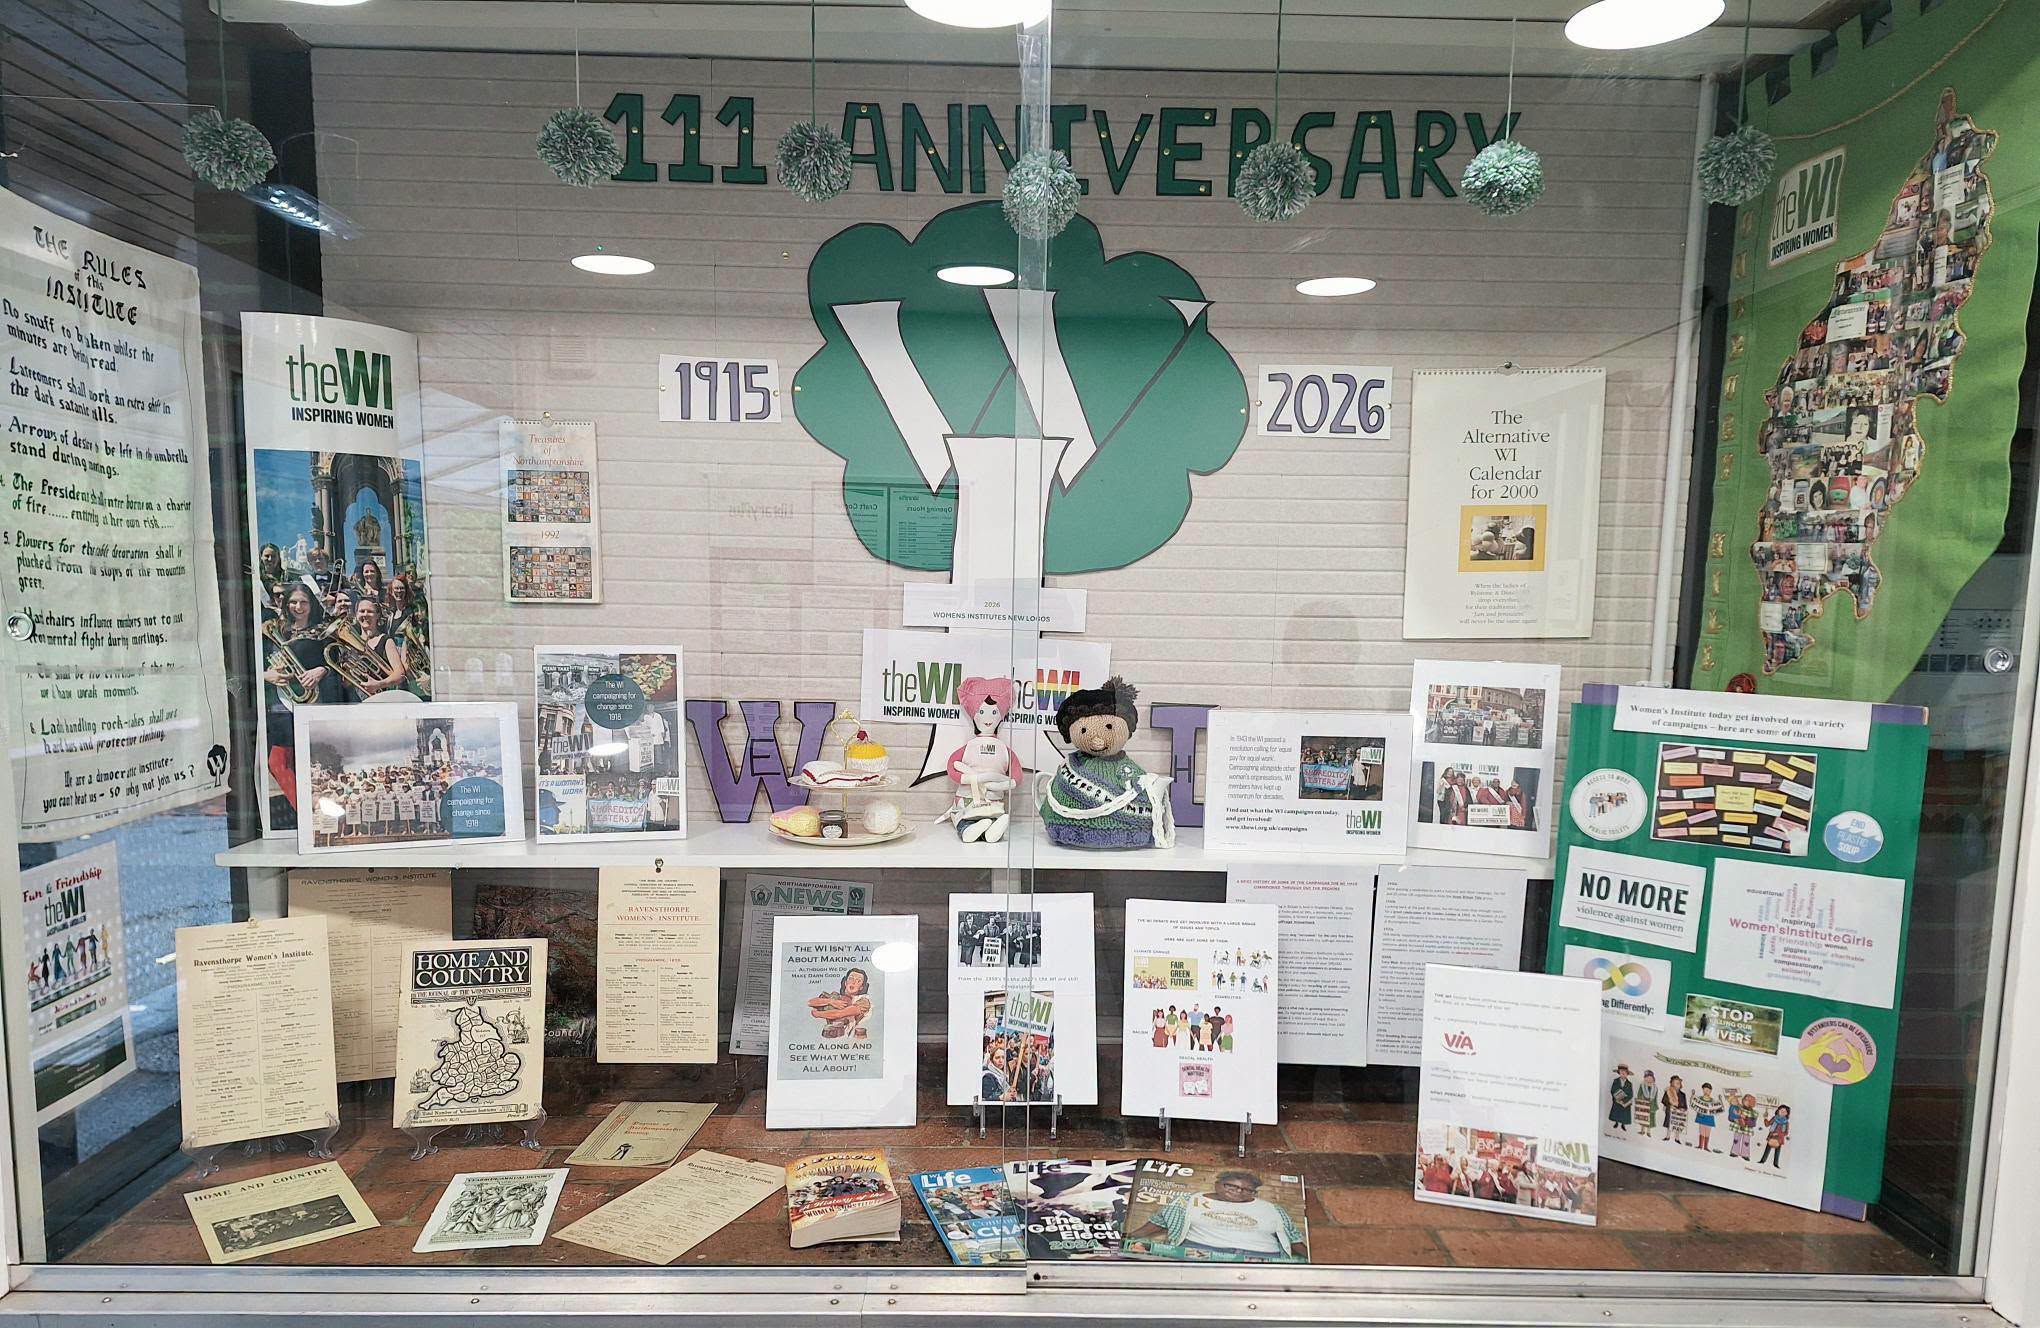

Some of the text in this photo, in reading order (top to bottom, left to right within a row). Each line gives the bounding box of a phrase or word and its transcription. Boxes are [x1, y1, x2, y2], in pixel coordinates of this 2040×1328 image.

[604, 93, 768, 185] 111
[1803, 223, 1833, 247] WOMEN
[82, 251, 147, 289] RULES
[25, 313, 54, 333] snuff
[675, 361, 771, 421] 1915
[1267, 372, 1385, 434] 2026
[292, 407, 394, 429] INSPIRING WOMEN
[1491, 410, 1522, 425] The
[1462, 430, 1550, 444] Alternative
[10, 442, 46, 459] stand
[1495, 448, 1517, 462] WI
[1469, 467, 1542, 480] Calendar
[1472, 485, 1538, 499] for 2000
[883, 706, 960, 719] INSPIRING WOMEN
[1630, 705, 1668, 715] Women's
[1670, 708, 1706, 718] Institute
[1709, 711, 1732, 721] today
[1735, 712, 1749, 722] get
[1751, 713, 1789, 725] involved
[1652, 718, 1660, 726] of
[1662, 720, 1707, 731] campaigns
[1718, 724, 1736, 732] here
[1739, 726, 1754, 734] are
[1782, 727, 1791, 737] of
[1793, 729, 1816, 739] them
[23, 867, 101, 902] Fun Friendship
[774, 887, 844, 907] NEWS
[1580, 872, 1689, 916] NO MORE
[1577, 905, 1684, 933] violence against women
[1782, 918, 1815, 928] inspiring
[193, 957, 242, 967] Ravensthorpe
[246, 953, 278, 962] Women's
[417, 950, 528, 970] HOME AND
[1170, 961, 1184, 969] FAIR
[416, 965, 527, 986] COUNTRY
[1170, 970, 1190, 978] GREEN
[1170, 978, 1194, 986] FUTURE
[1711, 1006, 1753, 1023] STOP
[1014, 1161, 1062, 1175] Life
[1142, 1160, 1194, 1177] Life
[921, 1171, 971, 1188] Life
[194, 1189, 232, 1202] HOME
[240, 1182, 265, 1192] AND
[1028, 1224, 1113, 1233] General
[1041, 1215, 1080, 1225] The
[1049, 1240, 1100, 1250] 2024
